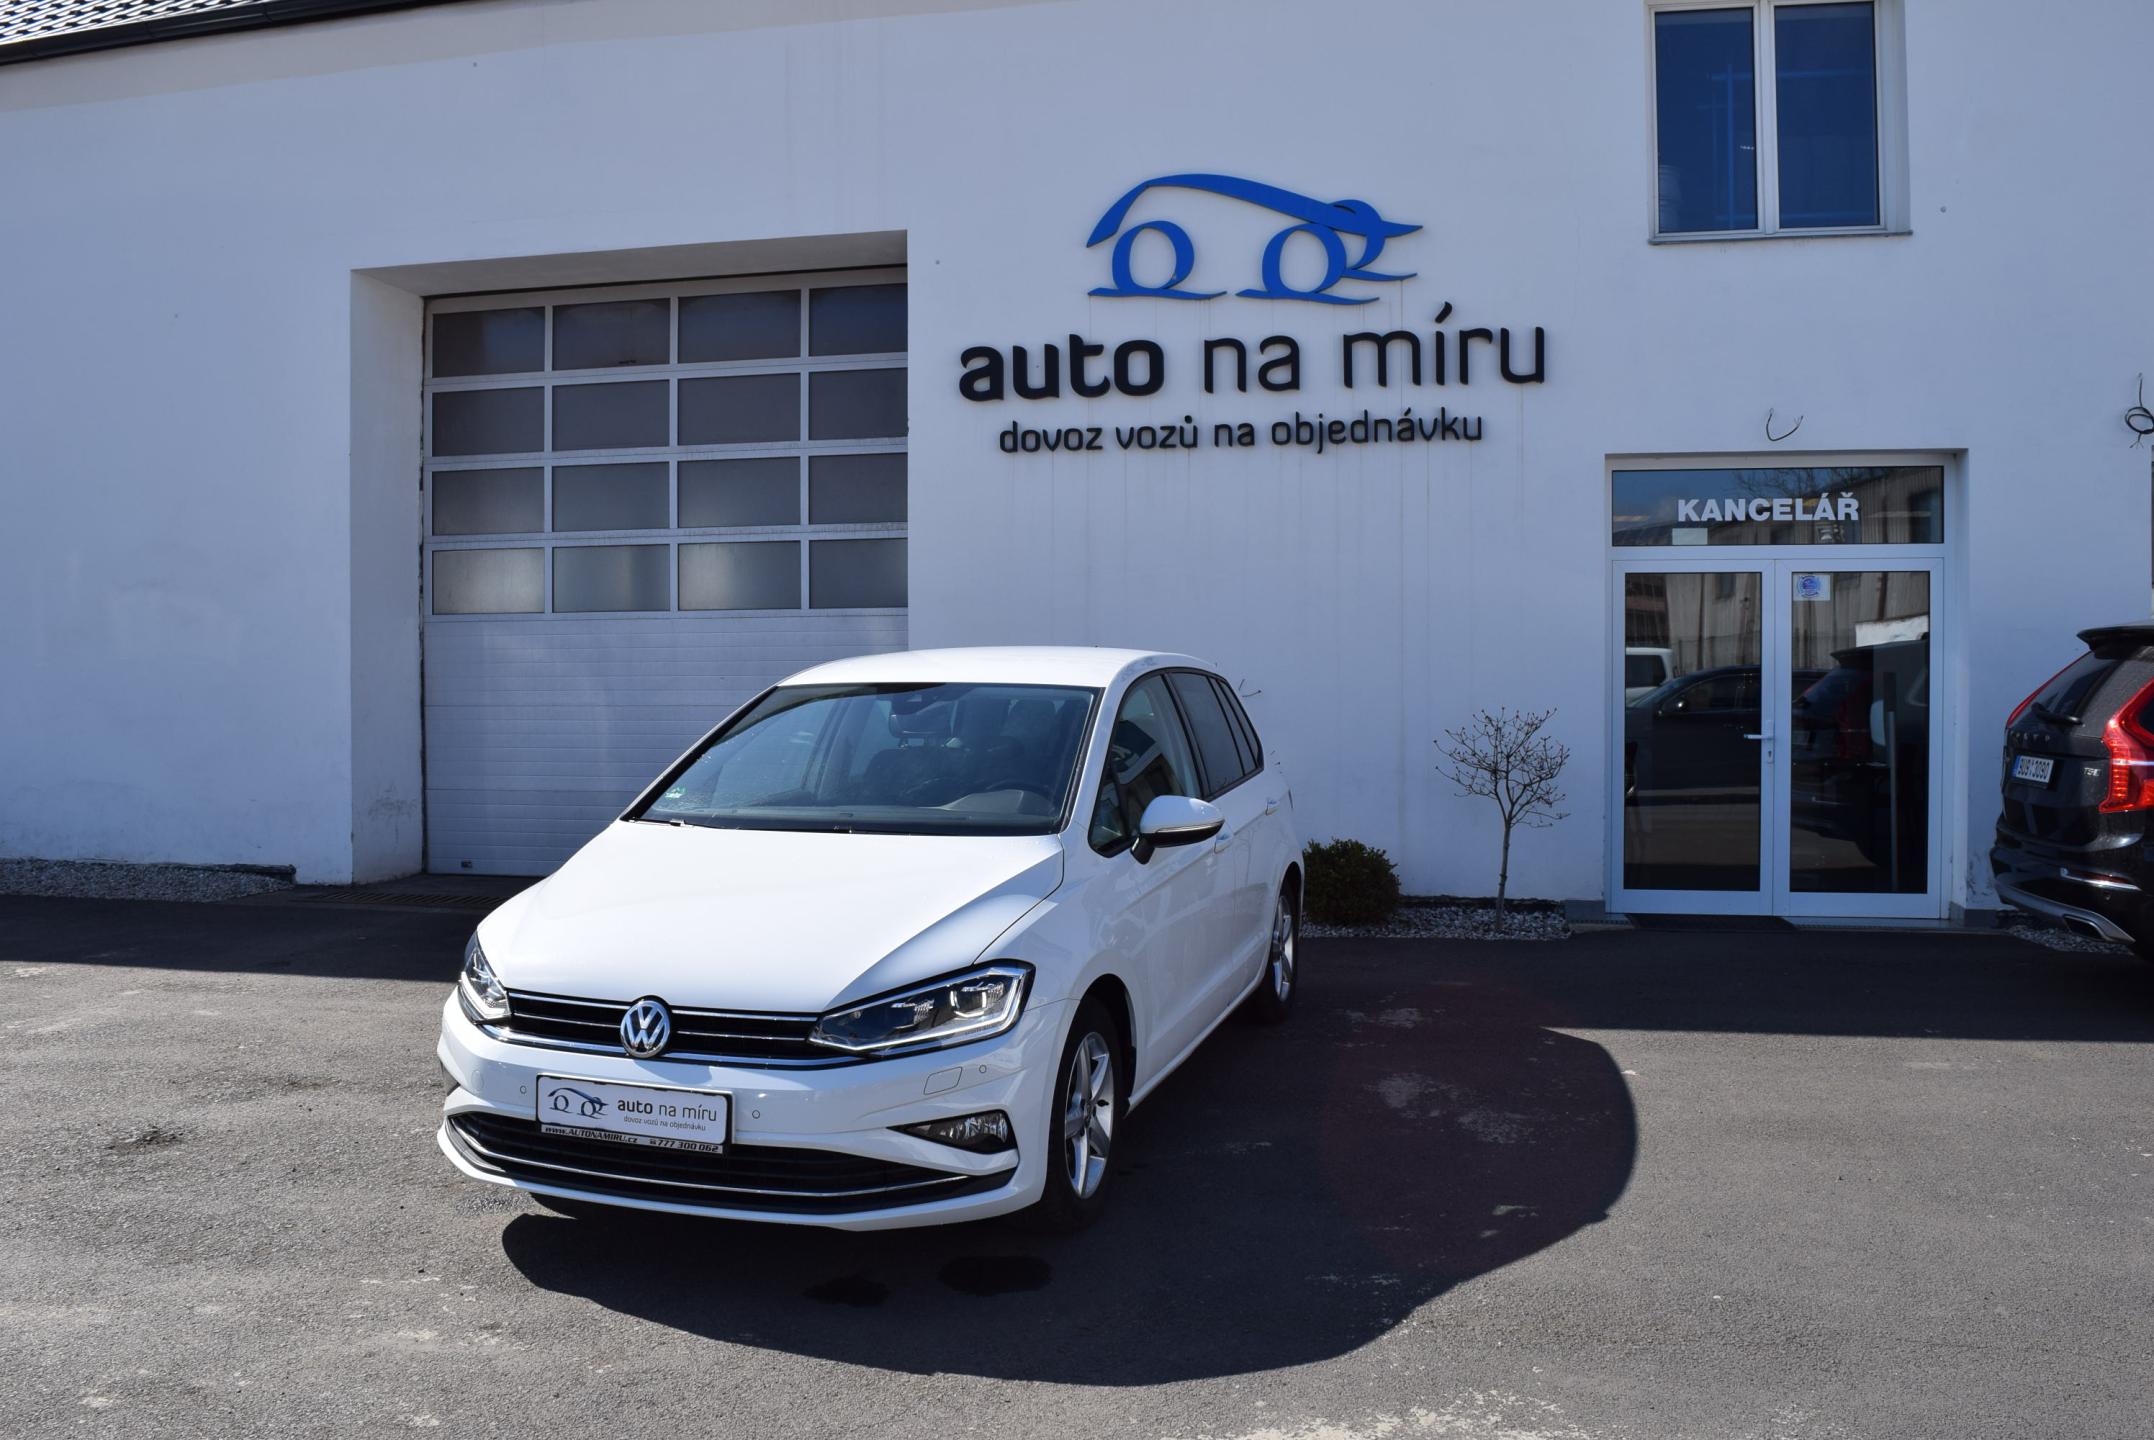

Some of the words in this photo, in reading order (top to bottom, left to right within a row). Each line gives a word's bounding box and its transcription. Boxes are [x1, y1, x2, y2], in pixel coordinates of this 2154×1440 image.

[959, 334, 1164, 401] auto
[1204, 335, 1300, 393] na
[1343, 302, 1545, 388] míru
[1000, 421, 1103, 453] dovoz
[1116, 415, 1198, 450] vozů
[1214, 419, 1255, 447] na
[1272, 407, 1482, 454] objednávku
[1678, 492, 1859, 522] KANCELÁŘ
[617, 1099, 653, 1115] auto
[658, 1104, 676, 1118] na
[682, 1104, 717, 1121] míru
[657, 1139, 675, 1148] 777
[676, 1142, 697, 1151] 300
